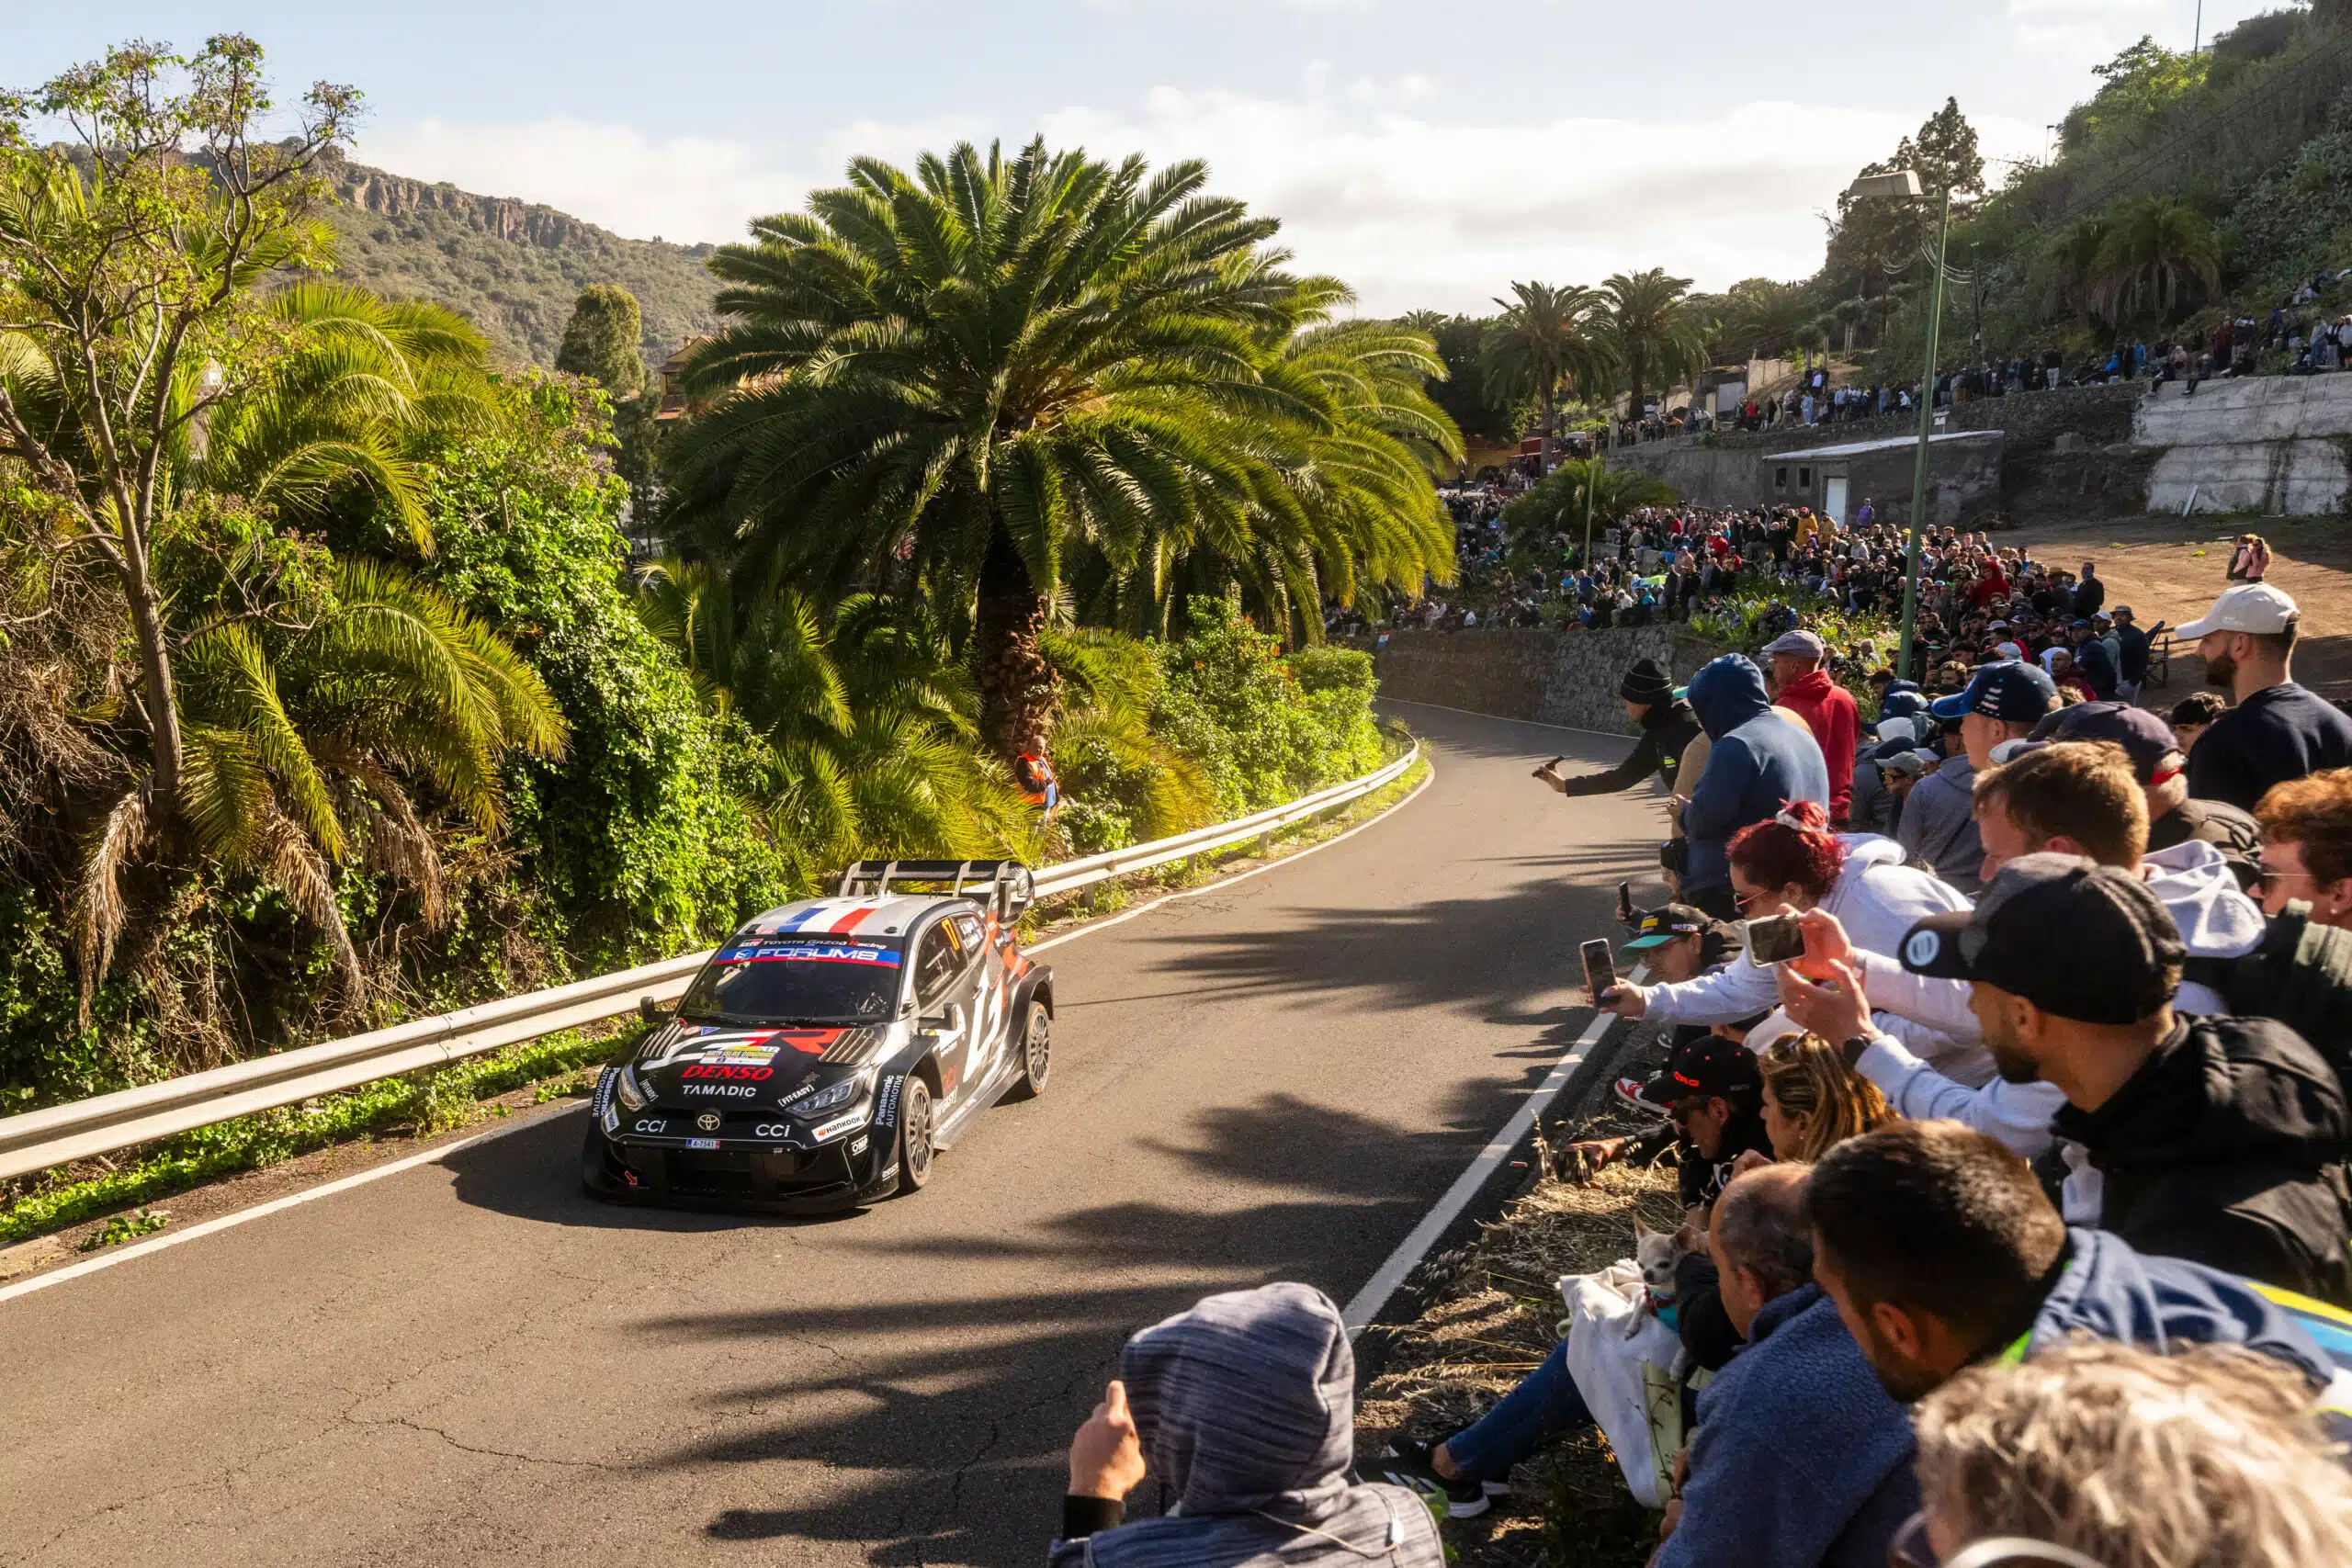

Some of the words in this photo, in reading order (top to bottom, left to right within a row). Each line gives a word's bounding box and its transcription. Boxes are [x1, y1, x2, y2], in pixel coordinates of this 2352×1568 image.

[941, 918, 961, 951] 17
[754, 948, 878, 962] FORUM8
[680, 1065, 774, 1081] DENSO
[592, 1066, 612, 1118] AUTOMOTIVE
[600, 1066, 621, 1116] Panasonic
[682, 1084, 756, 1099] TAMADIC
[875, 1074, 895, 1125] Panasonic
[886, 1074, 905, 1128] AUTOMOTIVE
[852, 1137, 868, 1153] OMP
